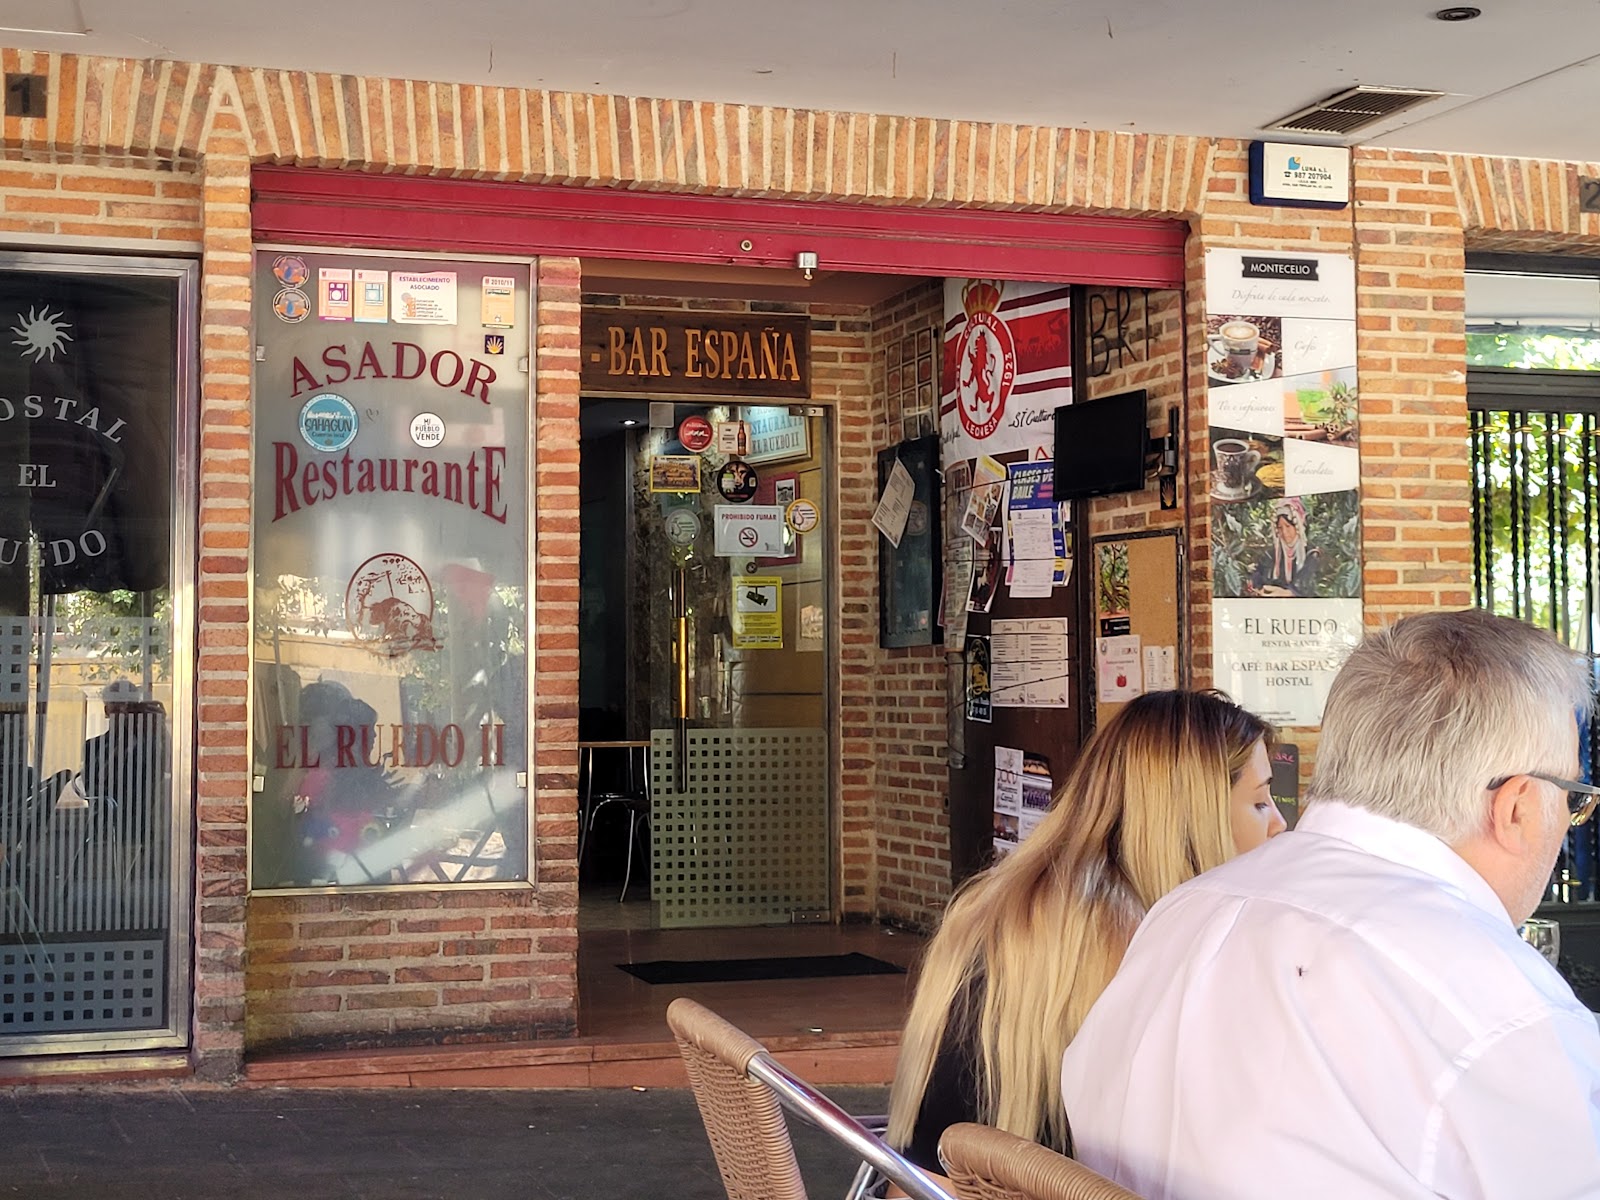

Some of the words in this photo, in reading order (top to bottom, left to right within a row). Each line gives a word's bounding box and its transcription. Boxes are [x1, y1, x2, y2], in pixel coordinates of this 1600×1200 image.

[1250, 262, 1311, 275] MONTECELIO
[399, 276, 451, 284] ESTABLECIMIENTO
[607, 326, 672, 377] BAR
[685, 326, 801, 381] ESPAÑA
[290, 341, 498, 404] ASADOR
[1002, 352, 1013, 387] 1923
[0, 395, 127, 443] OSTAL
[415, 424, 440, 432] PUEBLO
[415, 432, 440, 441] VENDE
[18, 464, 57, 488] EL
[1013, 469, 1042, 485] CLASES
[1011, 485, 1035, 500] BAILE
[0, 529, 107, 567] UEDO
[1244, 618, 1264, 635] EL
[1271, 618, 1338, 636] RUEDO
[1231, 660, 1263, 672] CAFÉ
[1266, 662, 1288, 672] BAR
[1266, 677, 1313, 687] HOSTAL
[275, 724, 321, 770] EL
[335, 723, 465, 768] RUEDO
